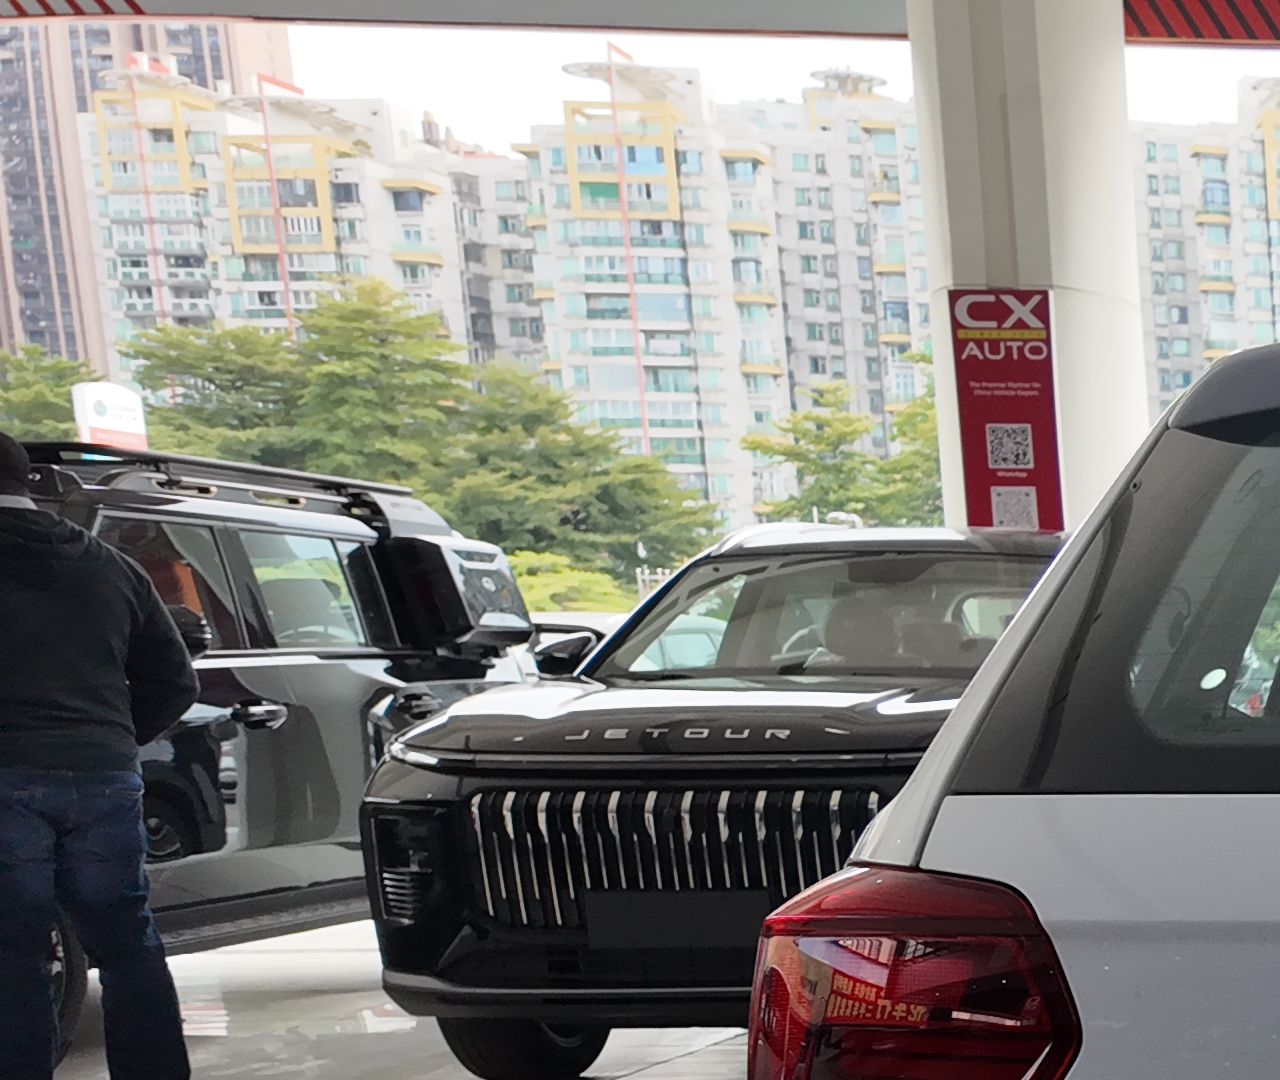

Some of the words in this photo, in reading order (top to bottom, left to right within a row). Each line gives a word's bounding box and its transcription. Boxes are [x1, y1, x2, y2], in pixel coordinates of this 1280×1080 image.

[954, 294, 1045, 328] CX
[961, 341, 1048, 361] AUTO
[564, 728, 791, 741] JETOUR
